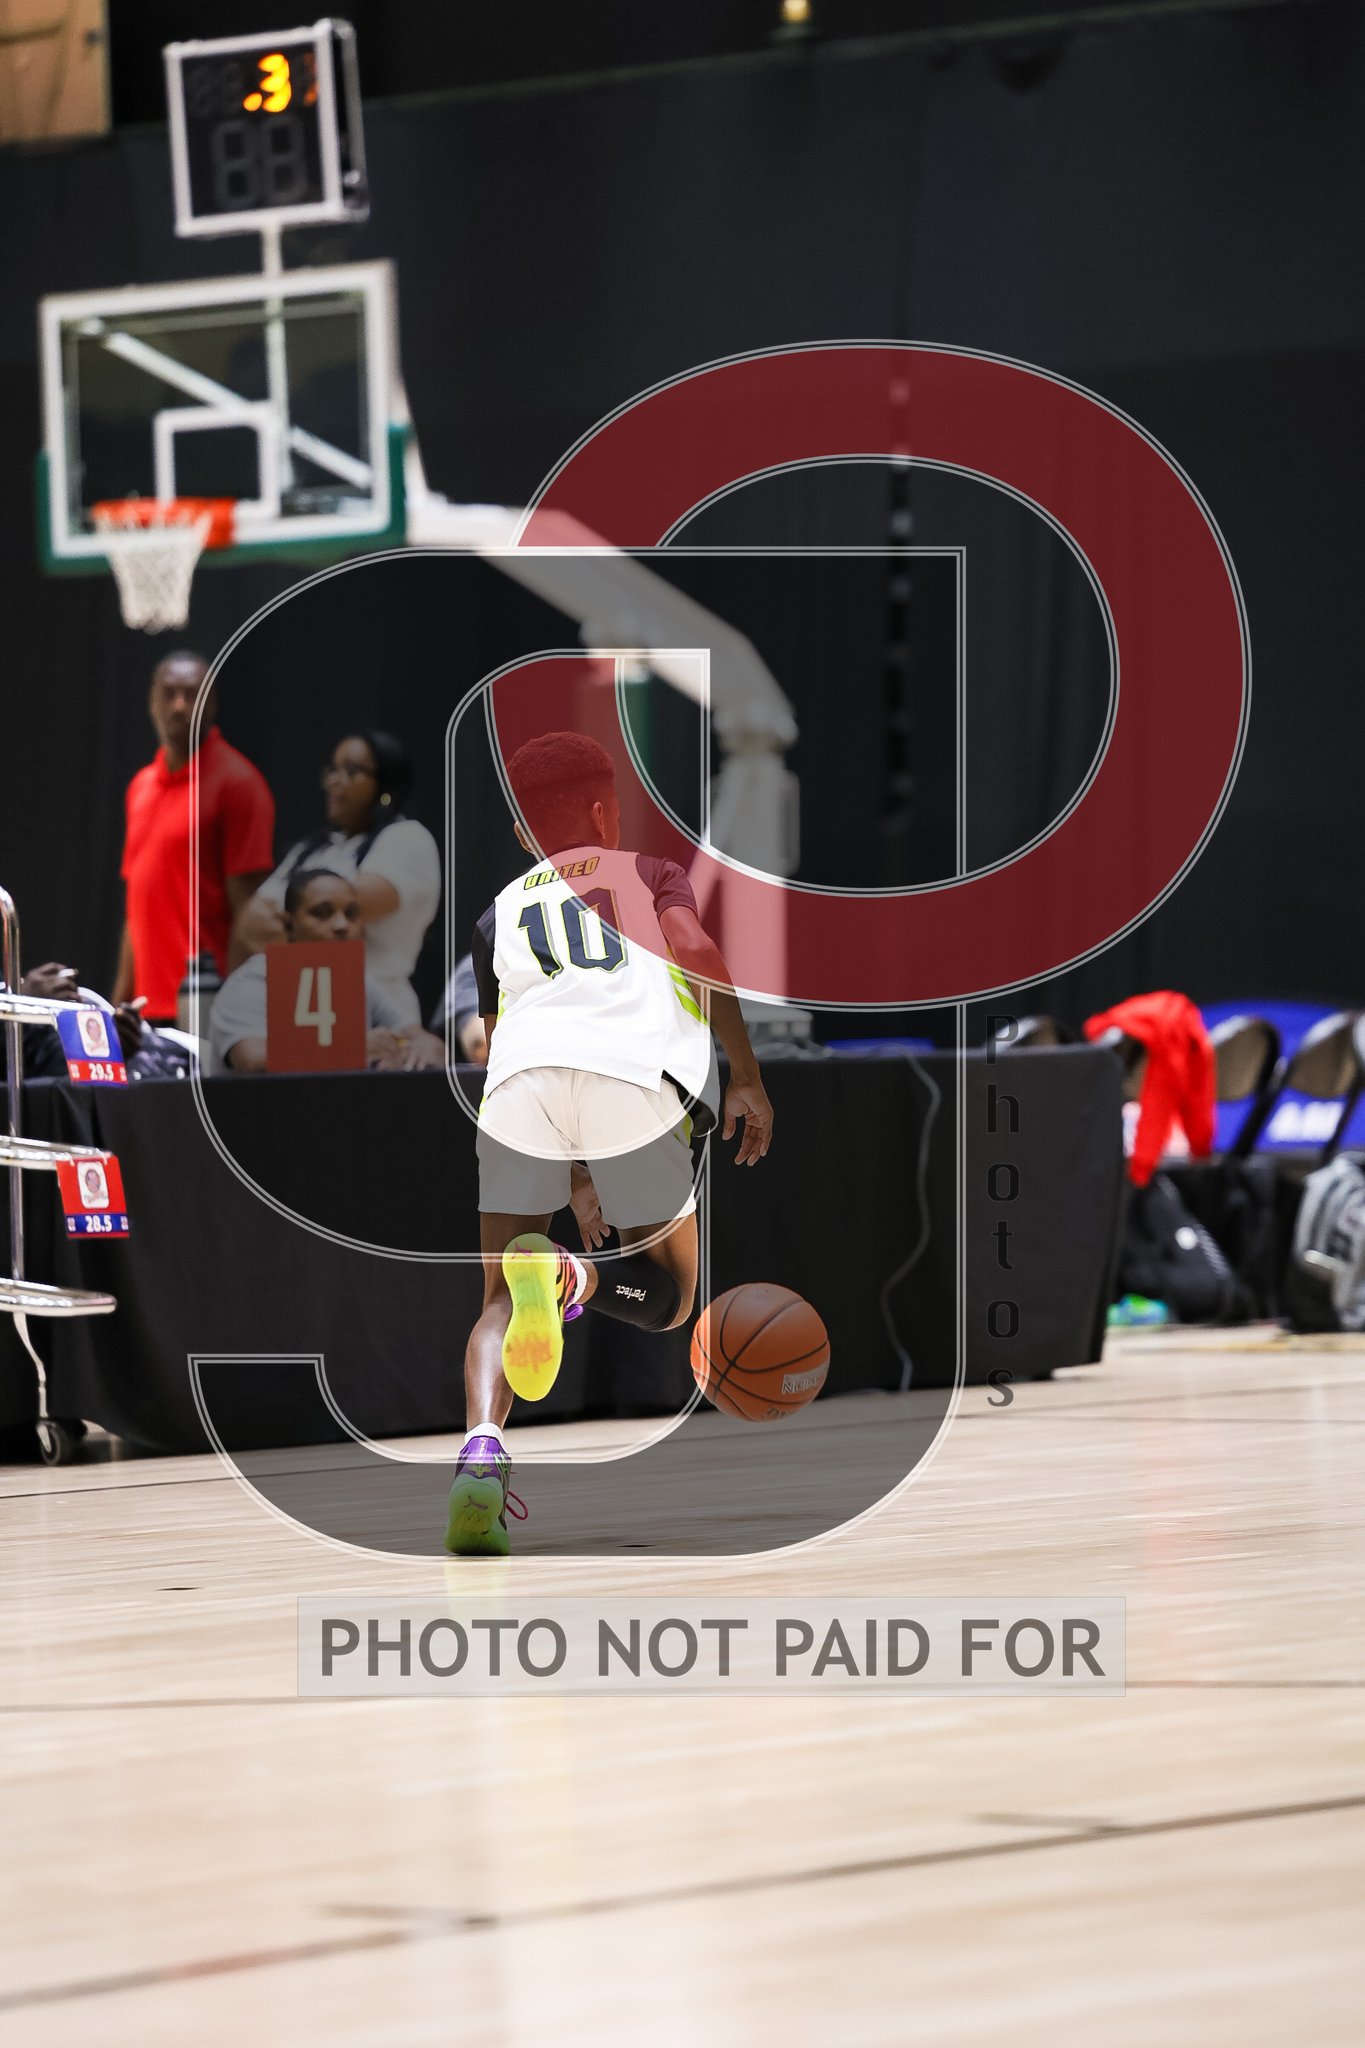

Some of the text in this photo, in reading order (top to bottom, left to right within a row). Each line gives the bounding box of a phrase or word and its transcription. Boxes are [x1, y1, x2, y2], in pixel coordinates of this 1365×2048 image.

[523, 856, 601, 891] UNITED
[517, 887, 629, 980] 10
[294, 966, 337, 1047] 4
[615, 1284, 647, 1302] Perfect
